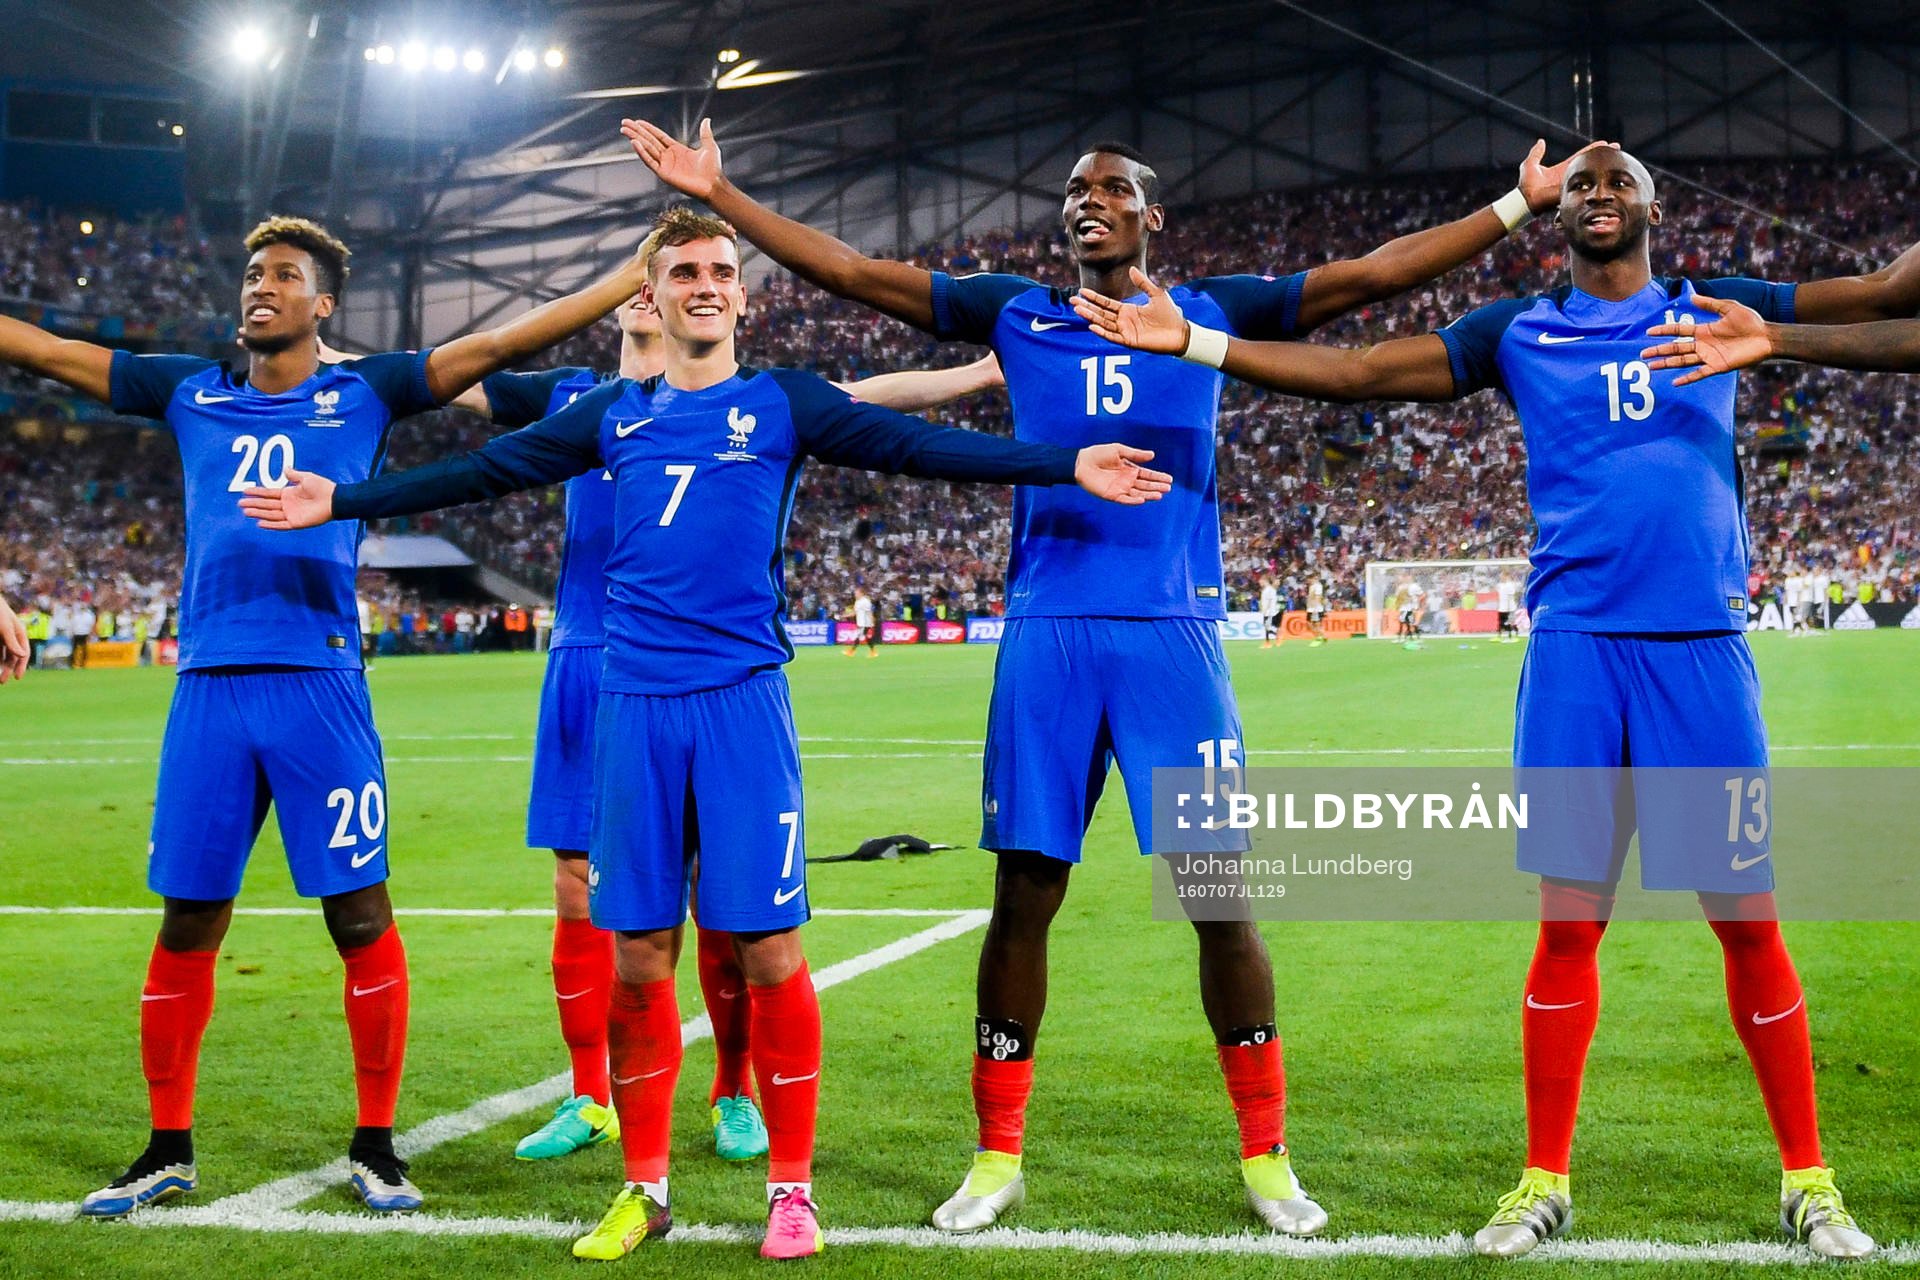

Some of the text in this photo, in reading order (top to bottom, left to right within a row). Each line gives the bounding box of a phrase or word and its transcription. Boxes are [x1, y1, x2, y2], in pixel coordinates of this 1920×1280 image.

[1080, 354, 1134, 416] 15
[1599, 360, 1655, 422] 13
[227, 433, 296, 494] 20
[658, 464, 697, 527] 7
[881, 628, 918, 641] SNCF
[927, 627, 964, 641] SNCF
[1197, 738, 1241, 805] 15
[327, 781, 386, 849] 20
[1724, 777, 1768, 843] 13
[778, 811, 799, 878] 7
